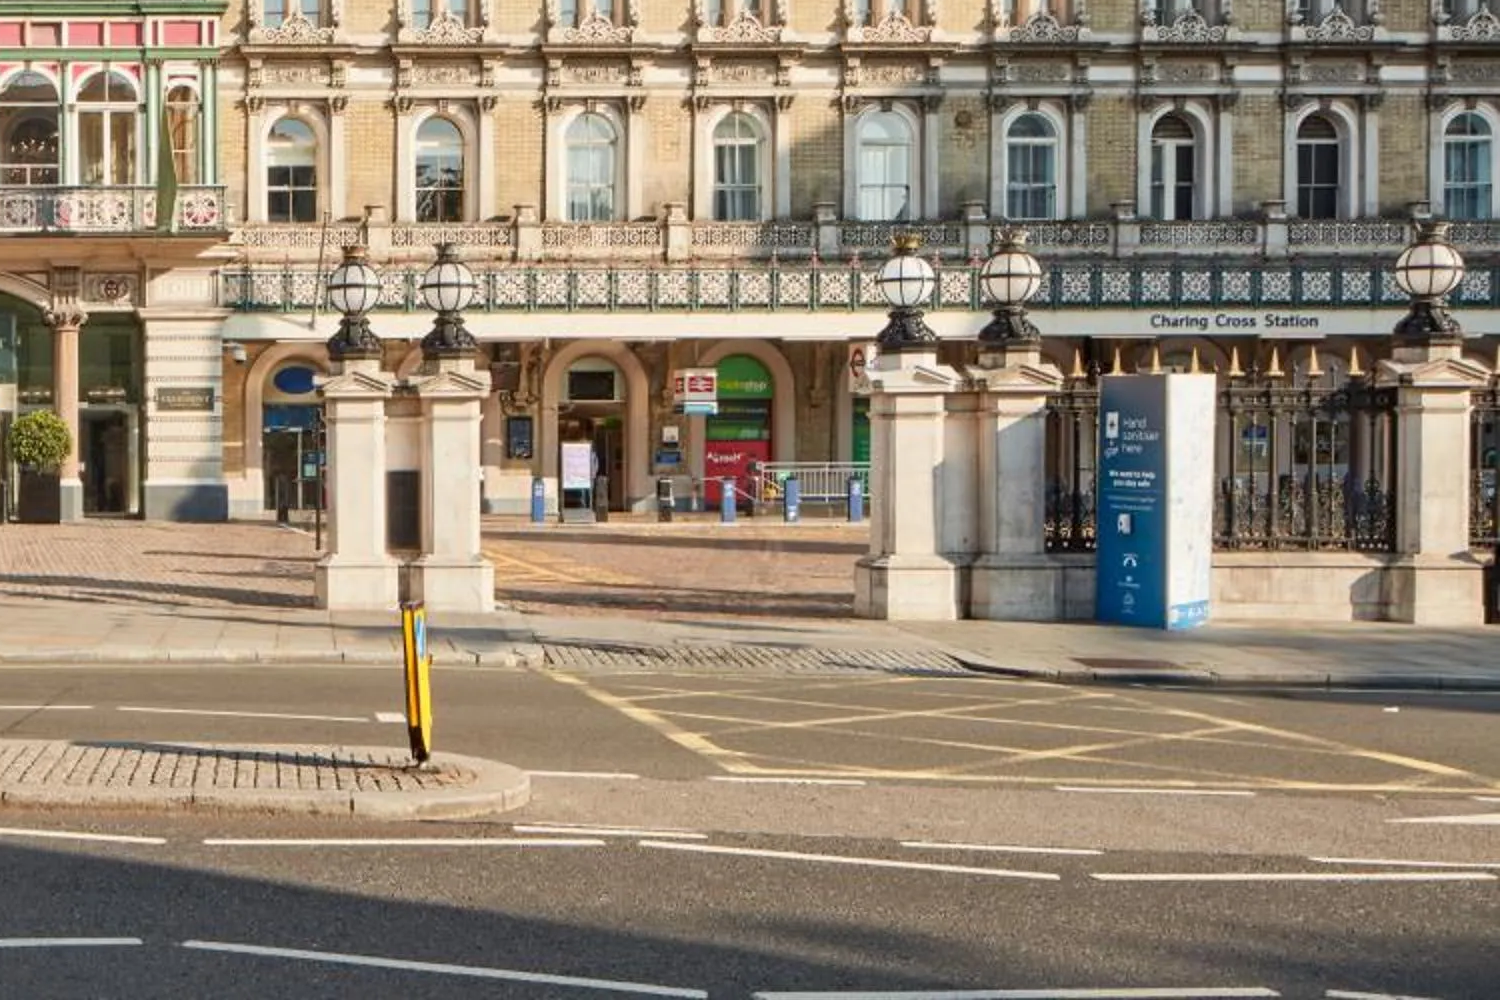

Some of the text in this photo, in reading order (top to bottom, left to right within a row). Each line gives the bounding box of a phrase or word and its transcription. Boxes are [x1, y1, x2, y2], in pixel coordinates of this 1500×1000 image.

[1150, 313, 1319, 330] Charing Cross Station
